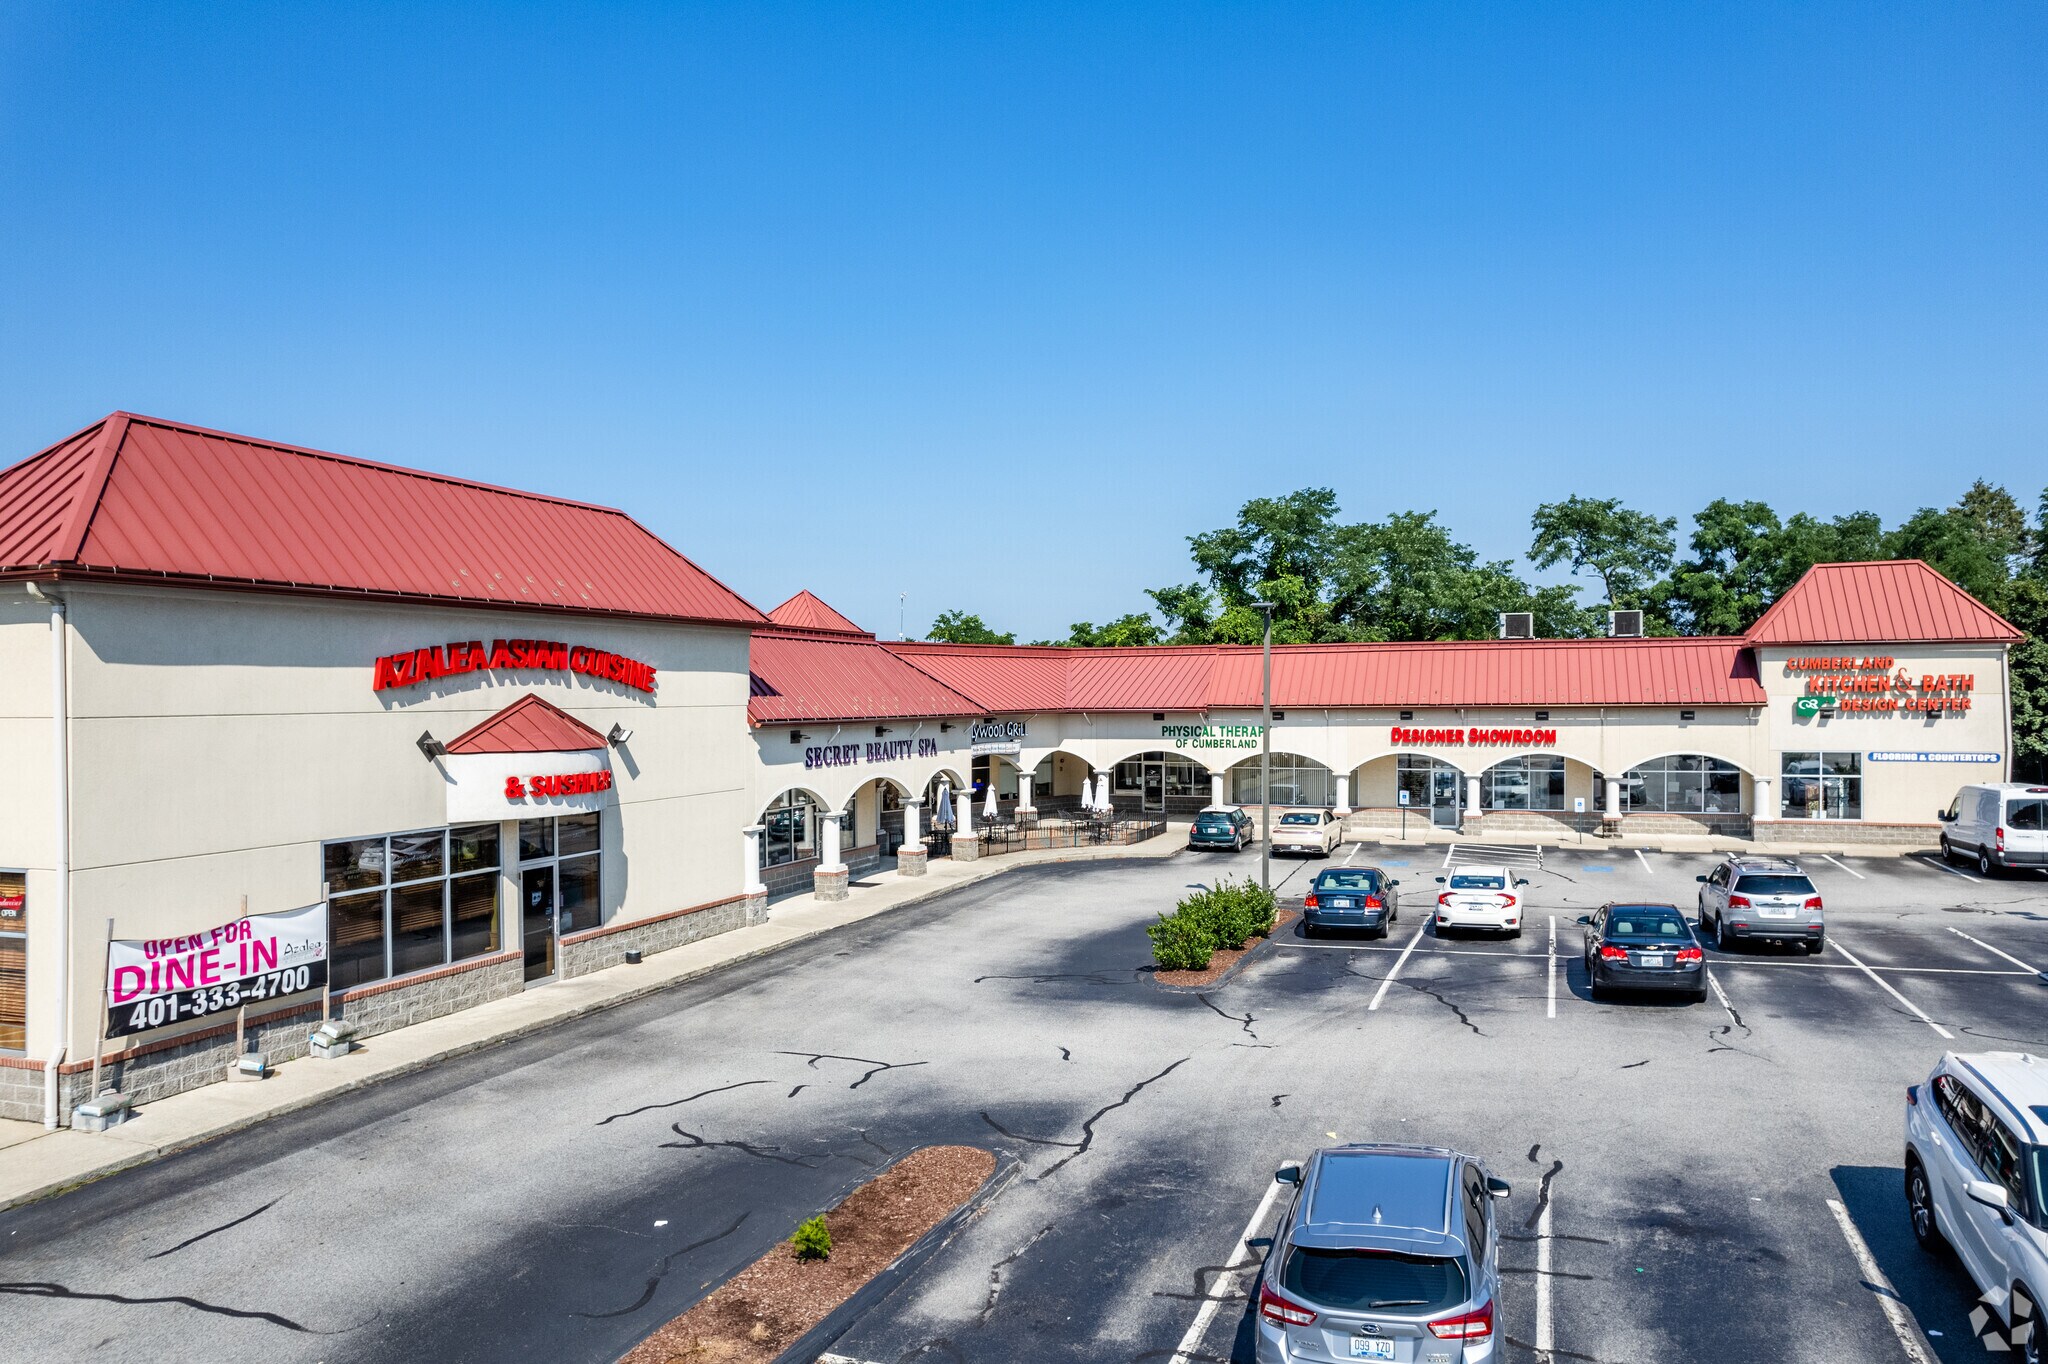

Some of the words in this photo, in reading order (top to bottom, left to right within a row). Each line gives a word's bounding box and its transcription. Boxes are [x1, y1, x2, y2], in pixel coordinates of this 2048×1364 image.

[373, 641, 489, 691] AZALEA
[489, 639, 568, 670] ASIAN
[569, 645, 657, 693] CUISINE
[1787, 656, 1895, 670] CUMBERLAND
[1809, 674, 1890, 692] KITCHEN
[1894, 667, 1915, 692] &
[1922, 674, 1974, 692] BATH
[1841, 698, 1899, 711] DESIGN
[1906, 698, 1972, 711] CENTER
[1161, 725, 1216, 738] PHYSICAL
[1219, 725, 1272, 738] THERAP
[1391, 727, 1465, 744] DESIGNER
[1468, 727, 1557, 744] SHOWROOM
[805, 743, 860, 768] SECRET
[866, 739, 914, 762] BEAUTY
[918, 737, 938, 757] SPA
[1175, 739, 1188, 749] OF
[1192, 739, 1258, 749] CUMBERLAND
[1872, 752, 1918, 761] FLOORING
[1919, 753, 1927, 761] &
[1928, 753, 1998, 762] COUNTERTOPS
[504, 775, 527, 799] &
[529, 772, 597, 798] SUSHI
[143, 933, 204, 960] OPEN
[211, 919, 252, 946] FOR
[284, 938, 321, 956] Azalea
[113, 936, 278, 1004] DINE-IN
[129, 965, 310, 1029] 401-333-4700
[1354, 1339, 1370, 1351] 099
